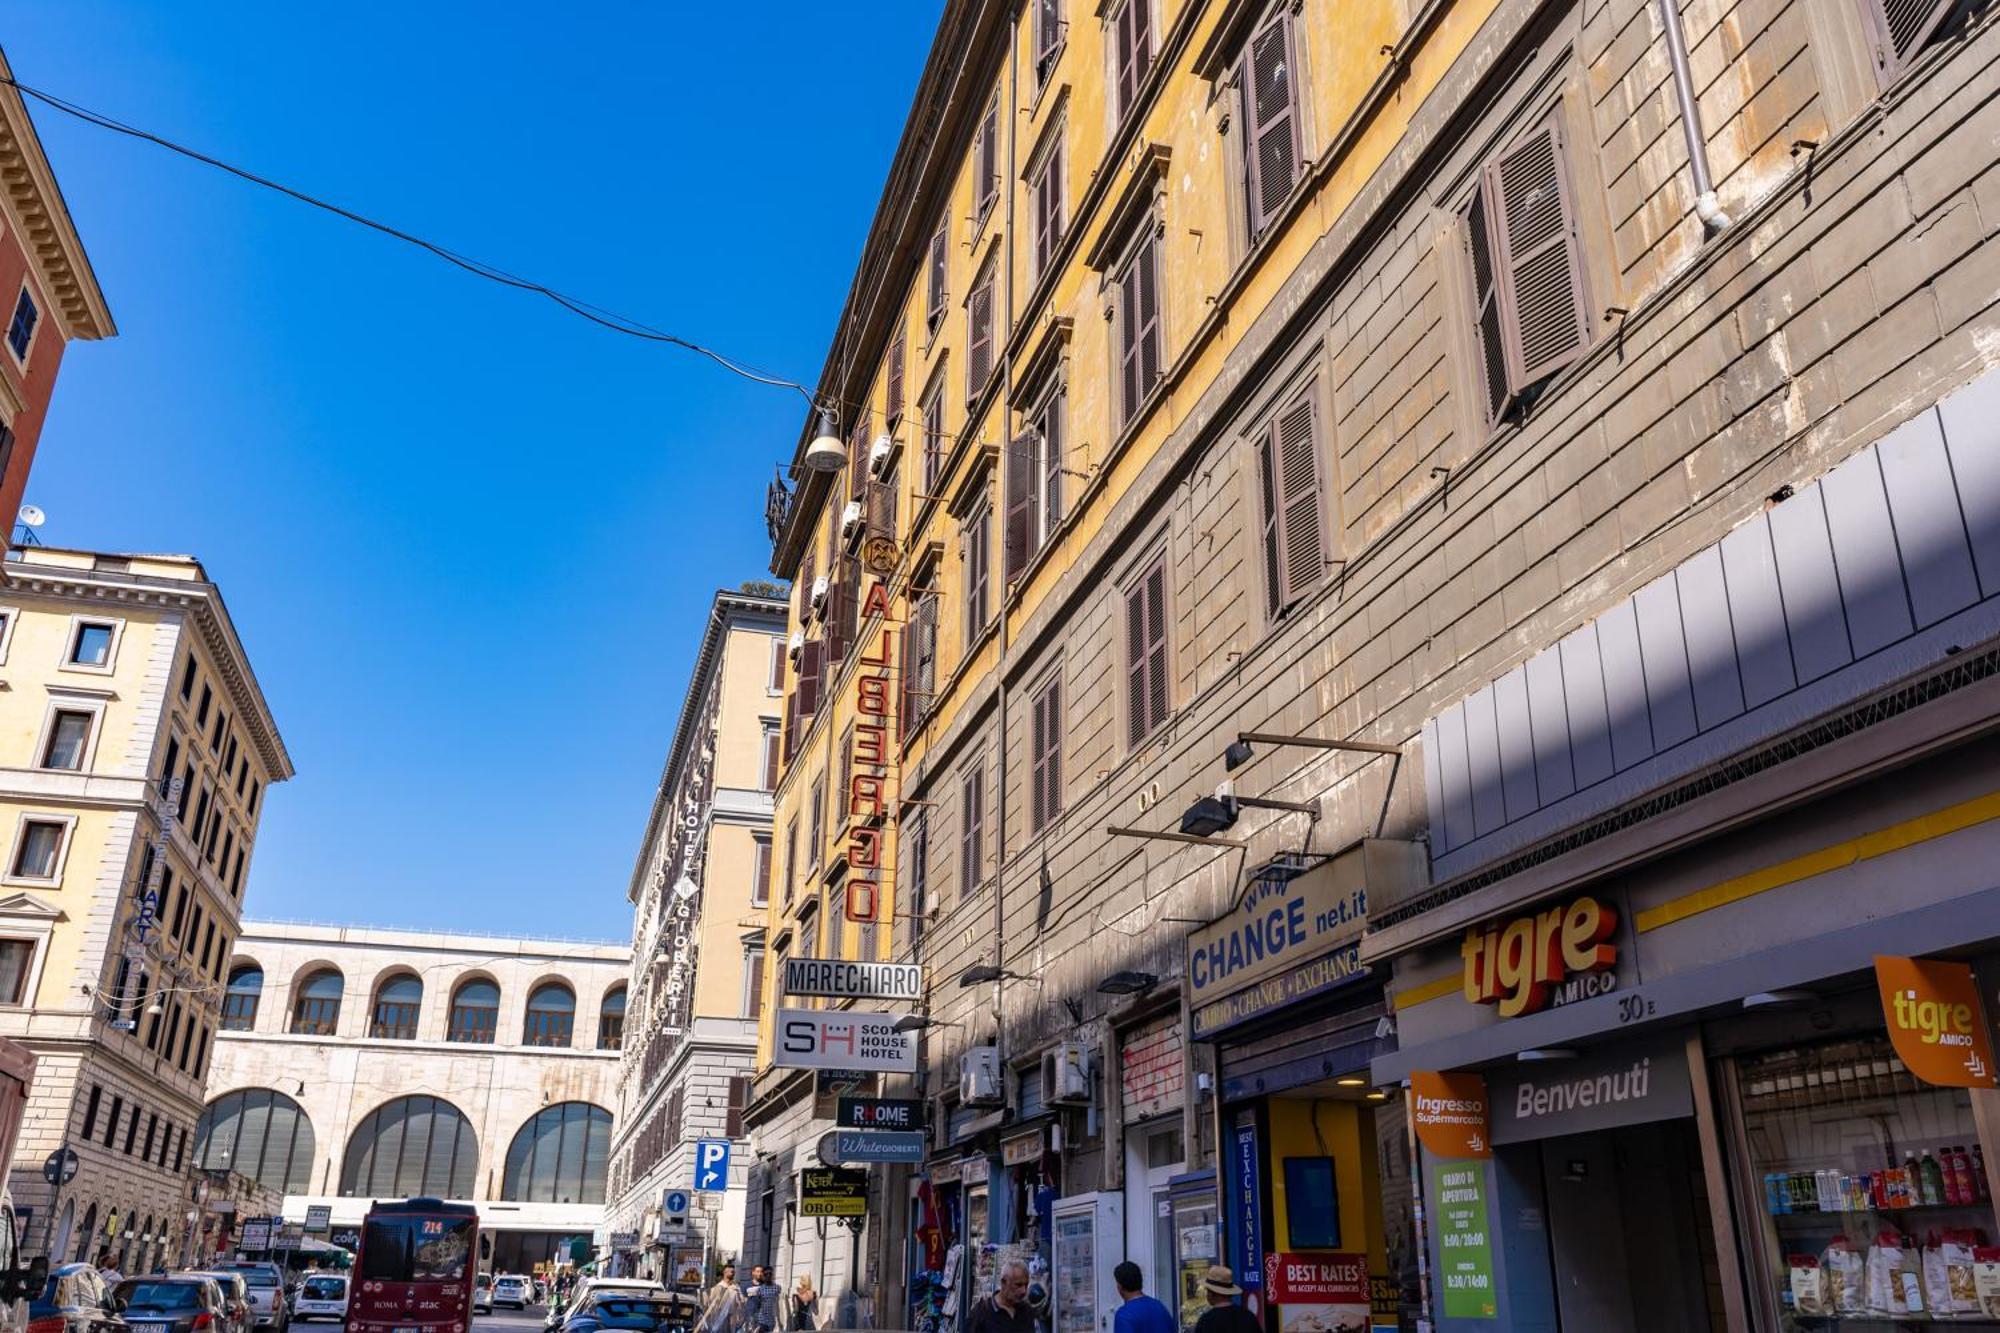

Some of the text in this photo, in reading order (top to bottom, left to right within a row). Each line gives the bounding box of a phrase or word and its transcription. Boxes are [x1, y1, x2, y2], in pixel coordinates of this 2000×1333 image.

[670, 802, 699, 1026] HOTEL GIOBERTI
[1191, 889, 1366, 989] CHANGE net.it
[1461, 897, 1617, 1017] tigre
[788, 962, 919, 995] MARECHIARO
[1238, 977, 1285, 1016] CHANGE
[1553, 972, 1614, 1007] AMICO
[1619, 994, 1643, 1022] 30
[1893, 990, 1973, 1044] tigre
[861, 1025, 901, 1036] SCOT
[1939, 1033, 1973, 1046] AMICO
[861, 1037, 908, 1048] HOUSE
[861, 1049, 904, 1060] HOTEL
[1515, 1057, 1650, 1119] Benvenuti
[853, 1106, 909, 1122] RHOME
[1416, 1094, 1483, 1115] Ingresso
[1416, 1112, 1484, 1125] Supermercato
[704, 1144, 725, 1170] P
[1243, 1144, 1255, 1267] EXCHANGE
[1441, 1188, 1480, 1204] APERTURA
[804, 1203, 834, 1214] ORO
[1287, 1264, 1359, 1282] BEST RATES
[373, 1301, 398, 1309] ROMA
[419, 1299, 439, 1309] atac
